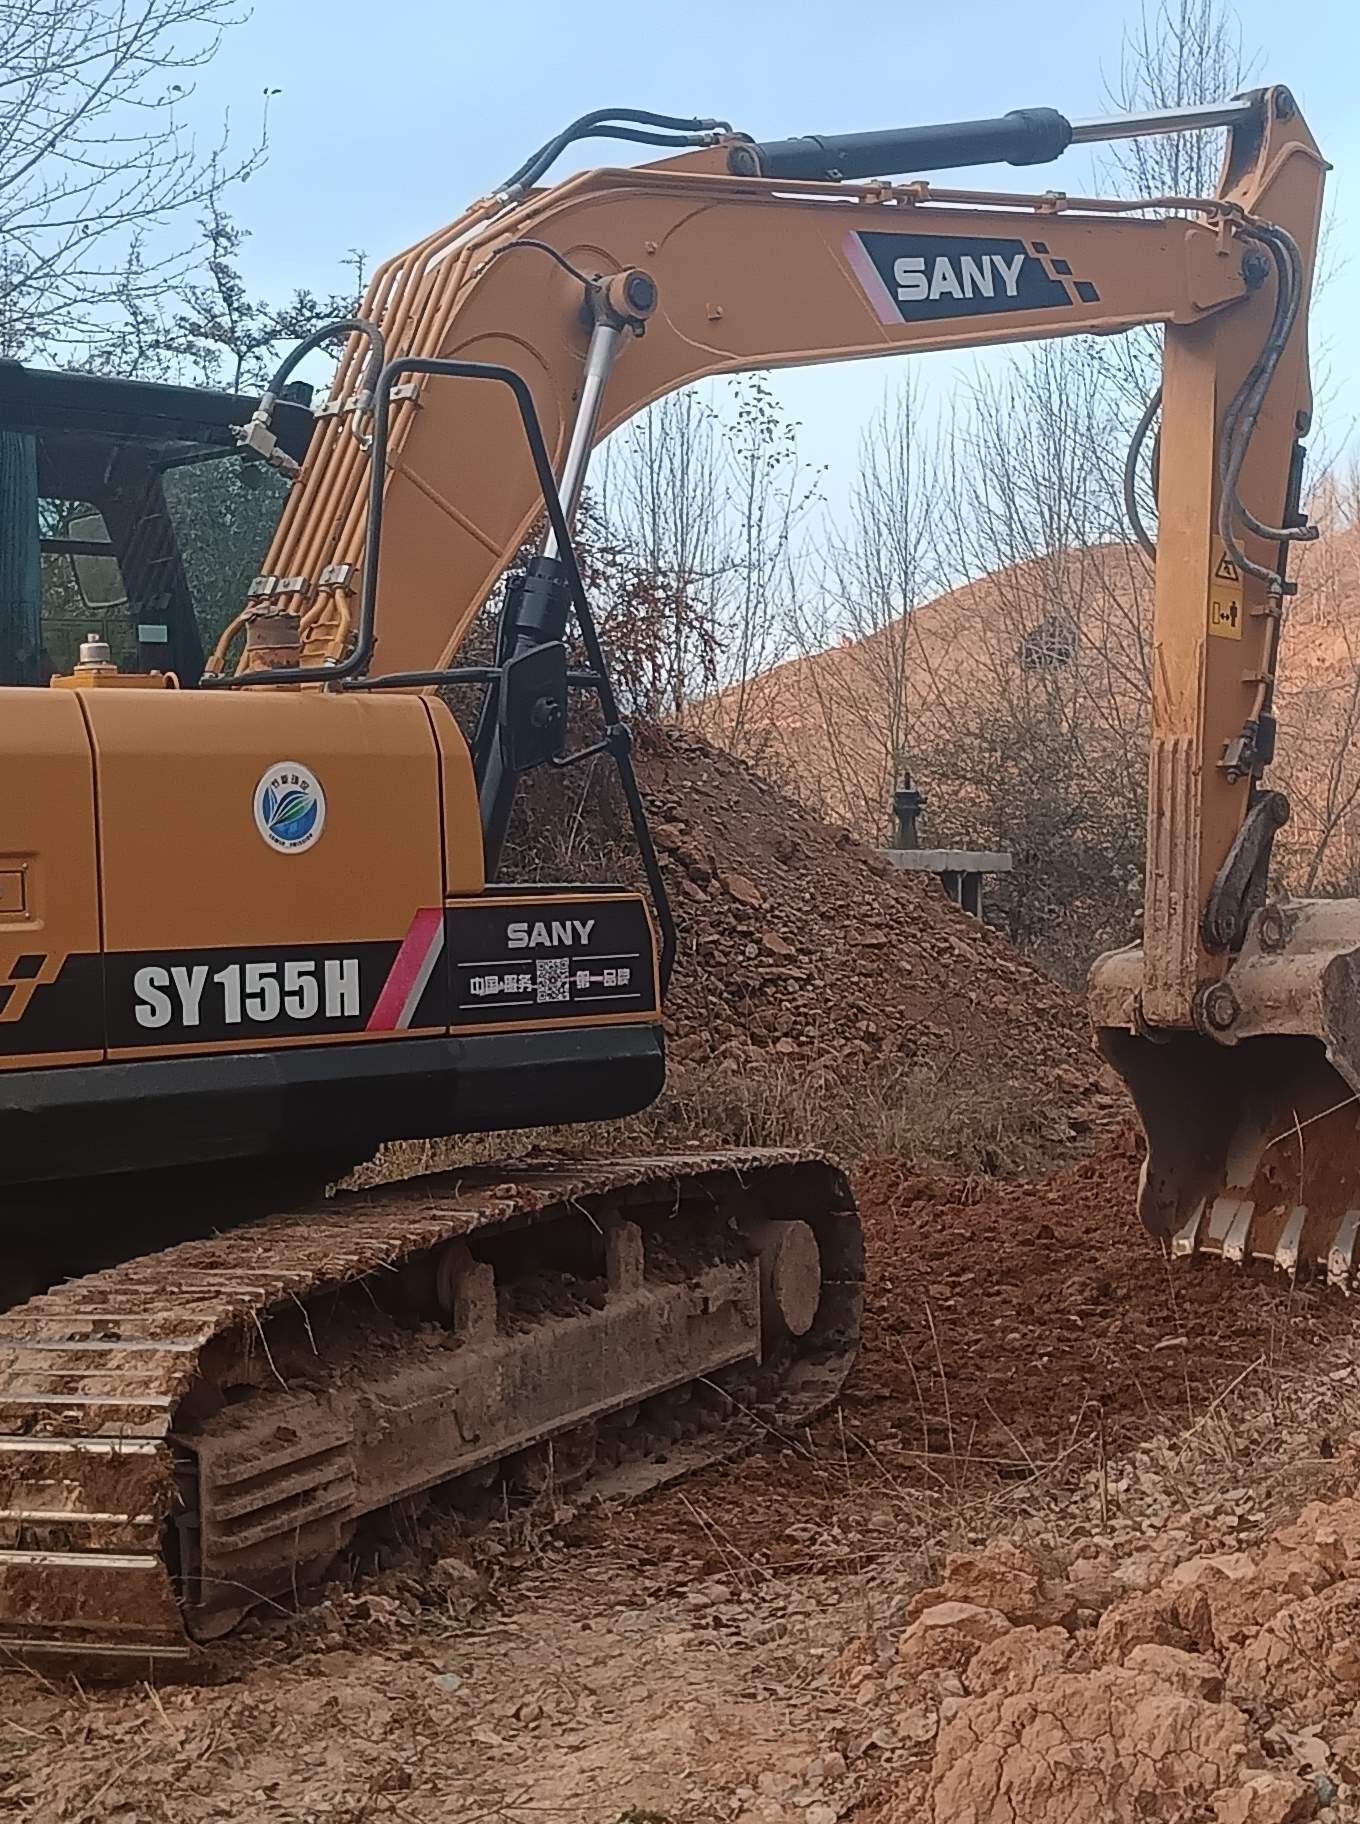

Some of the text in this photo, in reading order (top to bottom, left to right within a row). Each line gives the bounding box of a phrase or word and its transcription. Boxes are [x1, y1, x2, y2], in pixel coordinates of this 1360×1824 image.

[894, 254, 1025, 300] SANY
[507, 920, 595, 948] SANY
[134, 959, 360, 1028] SY155H
